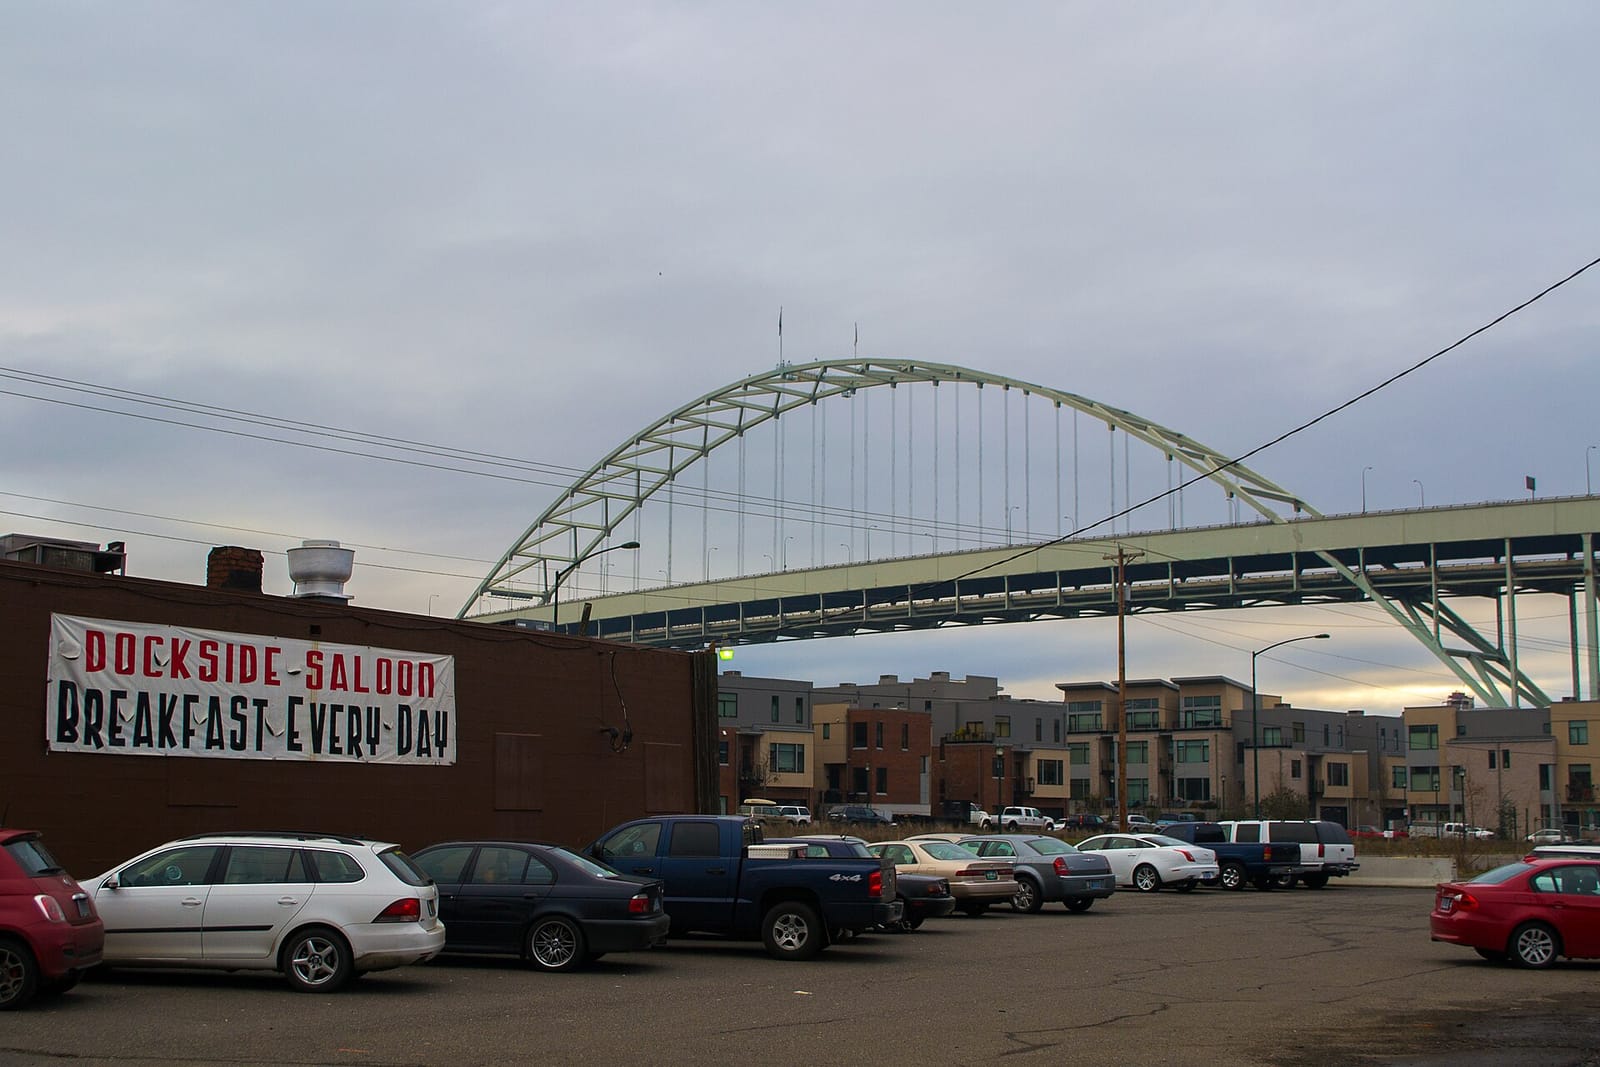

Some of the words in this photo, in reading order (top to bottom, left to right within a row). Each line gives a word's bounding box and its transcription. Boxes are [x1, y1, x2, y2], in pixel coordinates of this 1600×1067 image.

[85, 630, 281, 686] DOCKSIDE
[305, 650, 434, 699] SALOON
[56, 681, 268, 751] BREAKFAST
[287, 696, 381, 760] EVERY
[398, 704, 449, 758] DAY
[829, 873, 862, 882] 4x4
